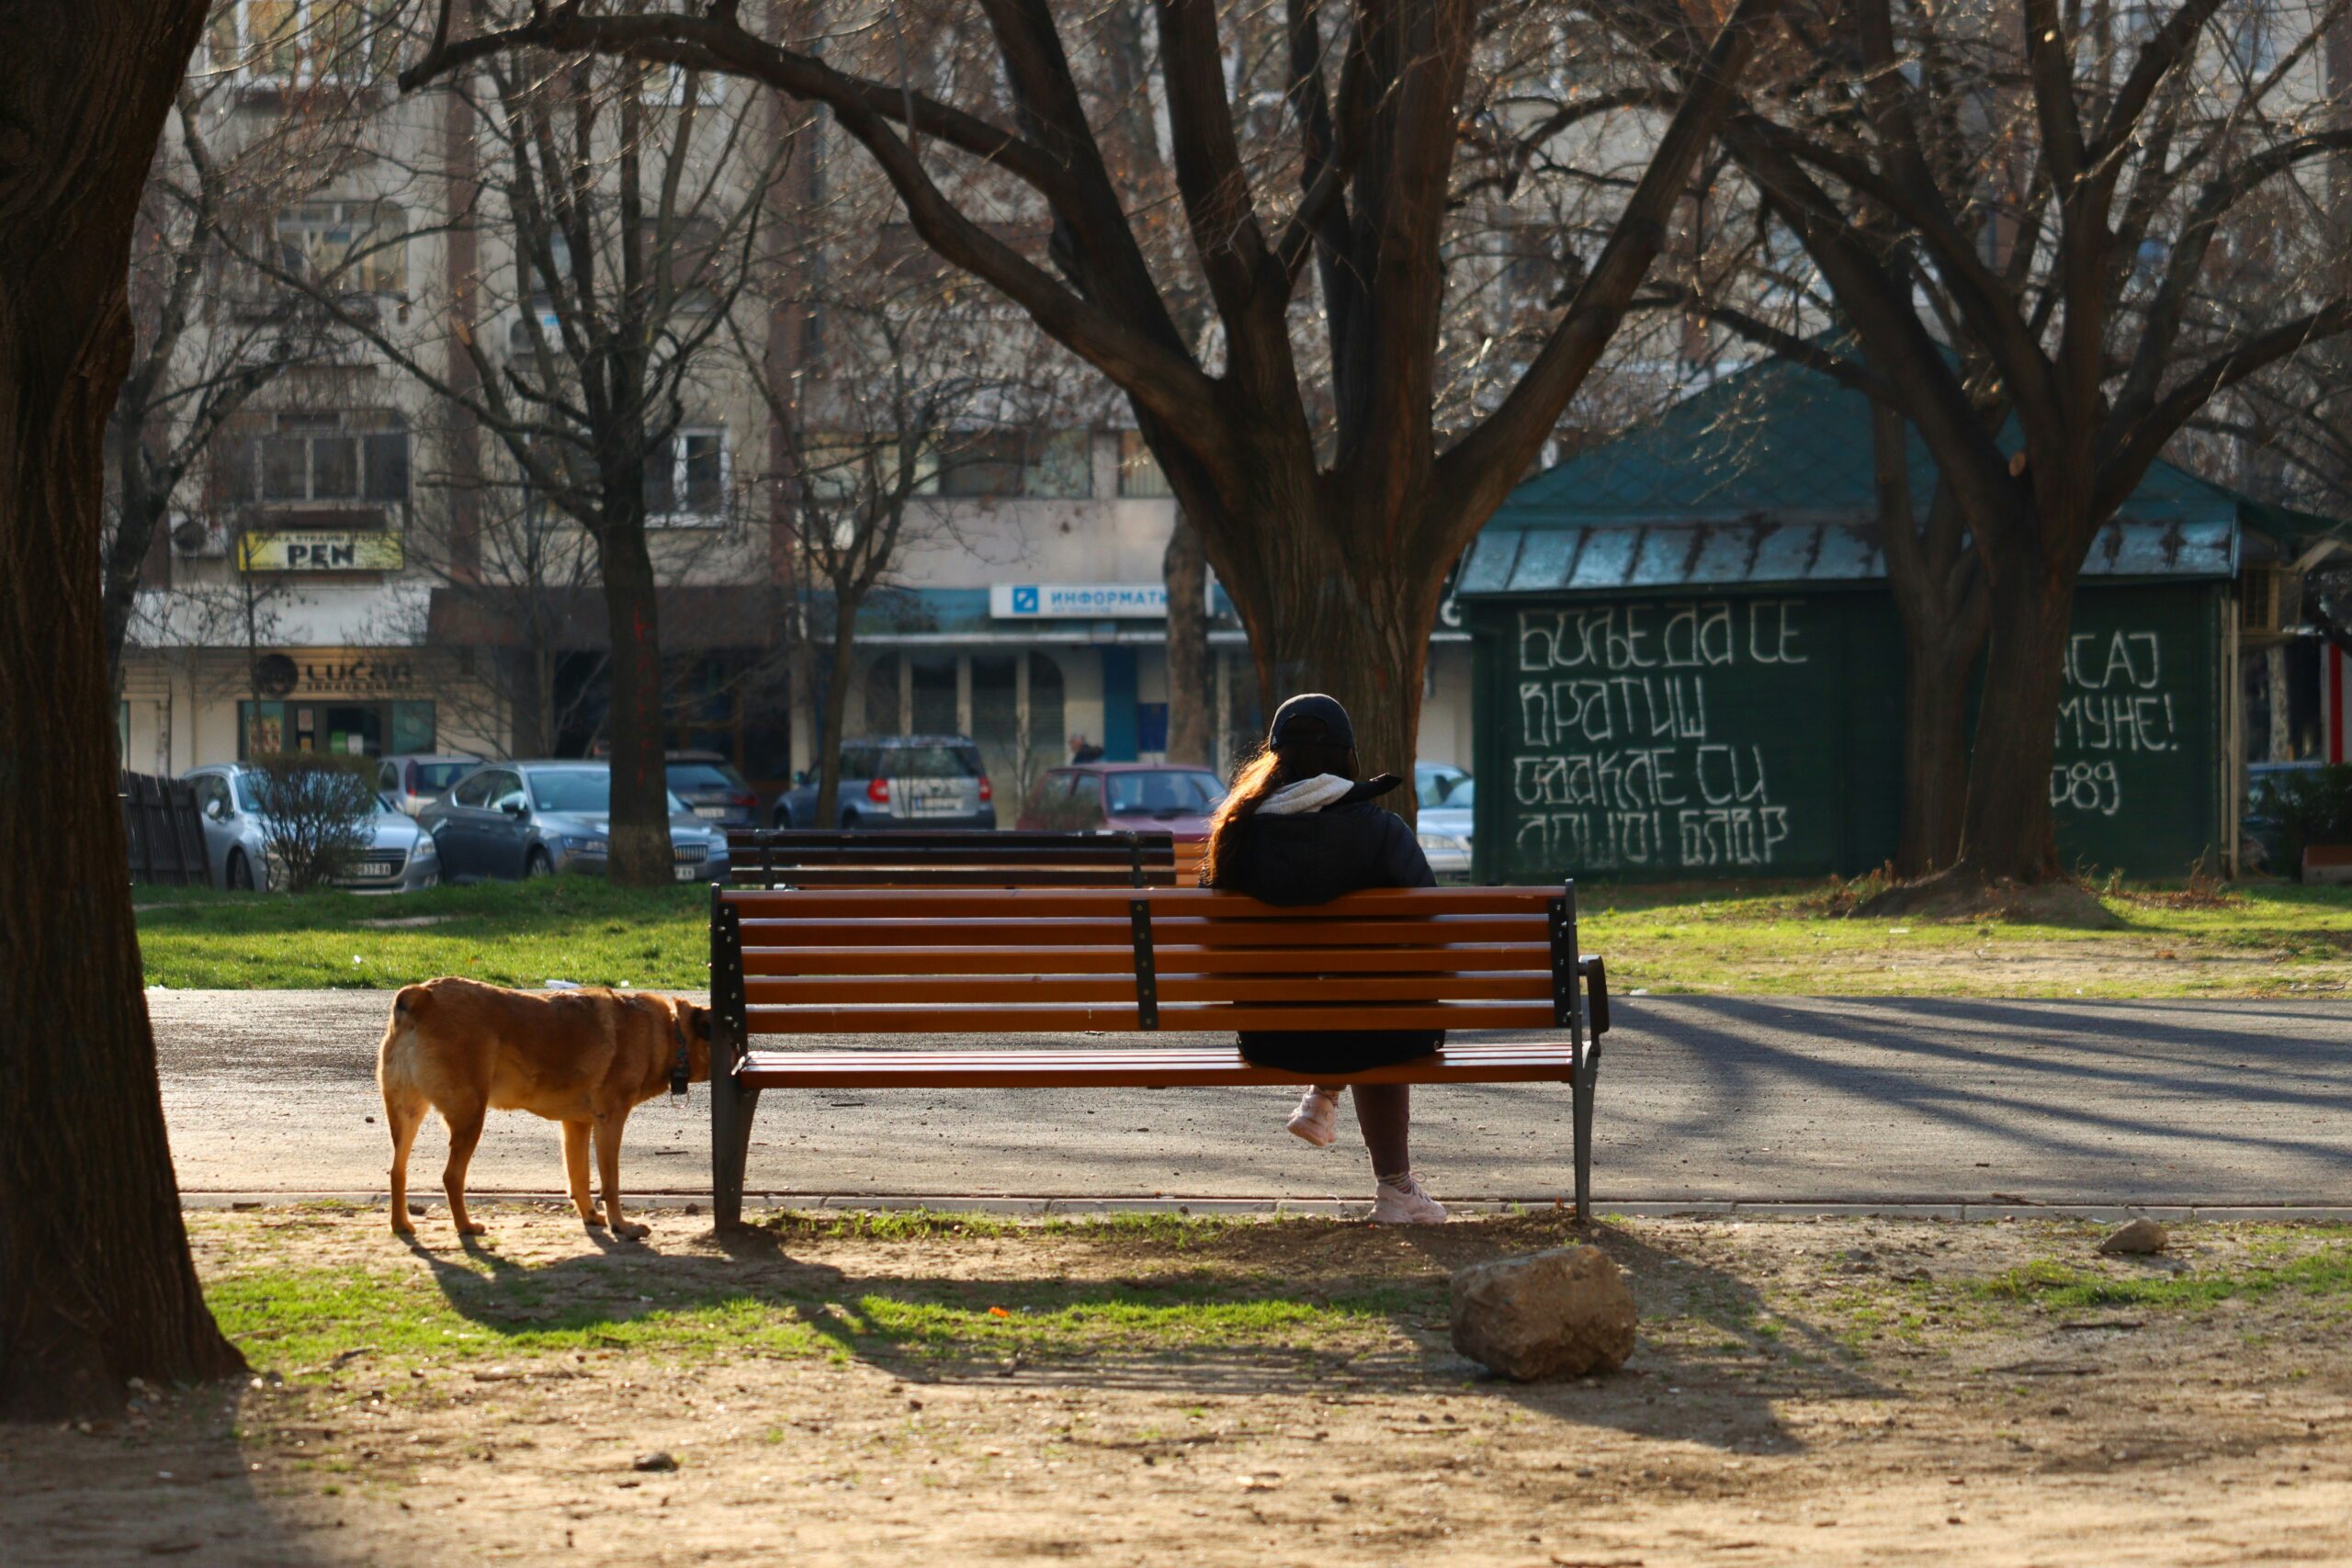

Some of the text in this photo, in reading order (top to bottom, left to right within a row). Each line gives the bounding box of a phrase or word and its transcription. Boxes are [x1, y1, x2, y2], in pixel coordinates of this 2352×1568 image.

[288, 544, 355, 566] PEN
[1662, 601, 1736, 669] ДА
[1748, 600, 1809, 664] СЕ
[1519, 674, 1707, 748] ВРАТИШ
[1696, 744, 1770, 807] СИ
